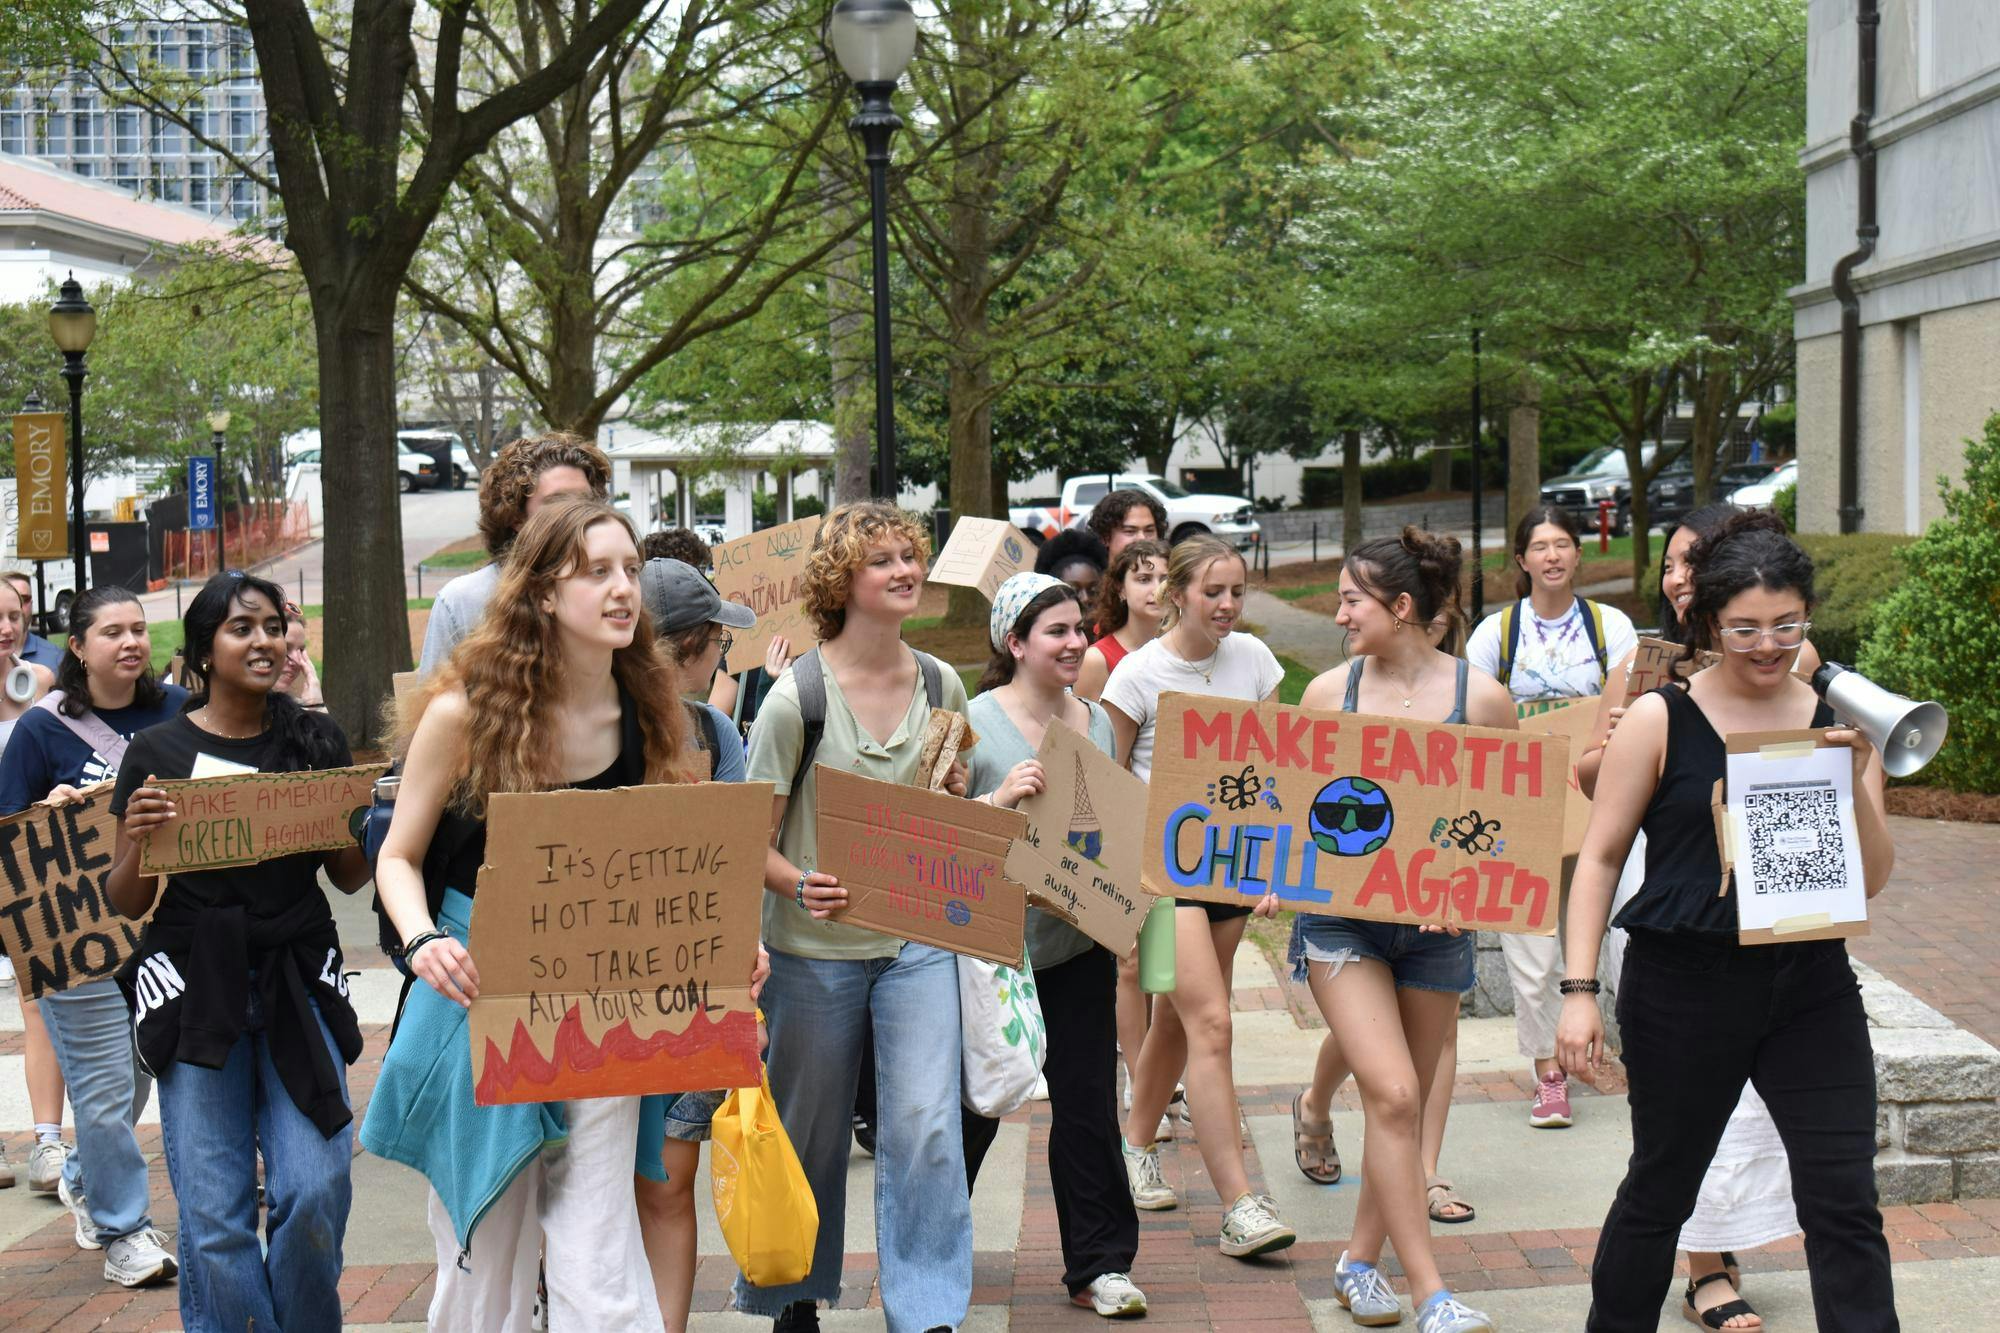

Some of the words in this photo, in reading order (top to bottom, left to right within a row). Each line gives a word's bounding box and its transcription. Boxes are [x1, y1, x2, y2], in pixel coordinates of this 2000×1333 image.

[29, 423, 53, 515] EMORY
[196, 461, 208, 508] EMORY
[718, 542, 752, 576] ACT
[766, 525, 802, 556] NOW
[1182, 707, 1340, 776] MAKE
[1359, 724, 1543, 798] EARTH
[166, 790, 238, 818] MAKE
[256, 782, 357, 812] AMERICA
[0, 796, 112, 897] THE
[177, 816, 254, 865] GREEN
[264, 815, 336, 850] AGAIN!!
[849, 840, 909, 877] GLOBAL
[1163, 802, 1333, 904] CHILL
[603, 842, 729, 890] GETTING
[1060, 856, 1080, 876] are
[1092, 875, 1137, 915] melting
[531, 898, 598, 935] HOT
[607, 898, 640, 927] IN
[885, 878, 945, 922] NOW
[1044, 873, 1087, 911] away...
[529, 954, 568, 980] SO
[586, 946, 663, 983] TAKE
[675, 935, 726, 974] OFF
[529, 989, 576, 1027] ALL
[585, 984, 649, 1023] YOUR
[655, 976, 726, 1016] COAL
